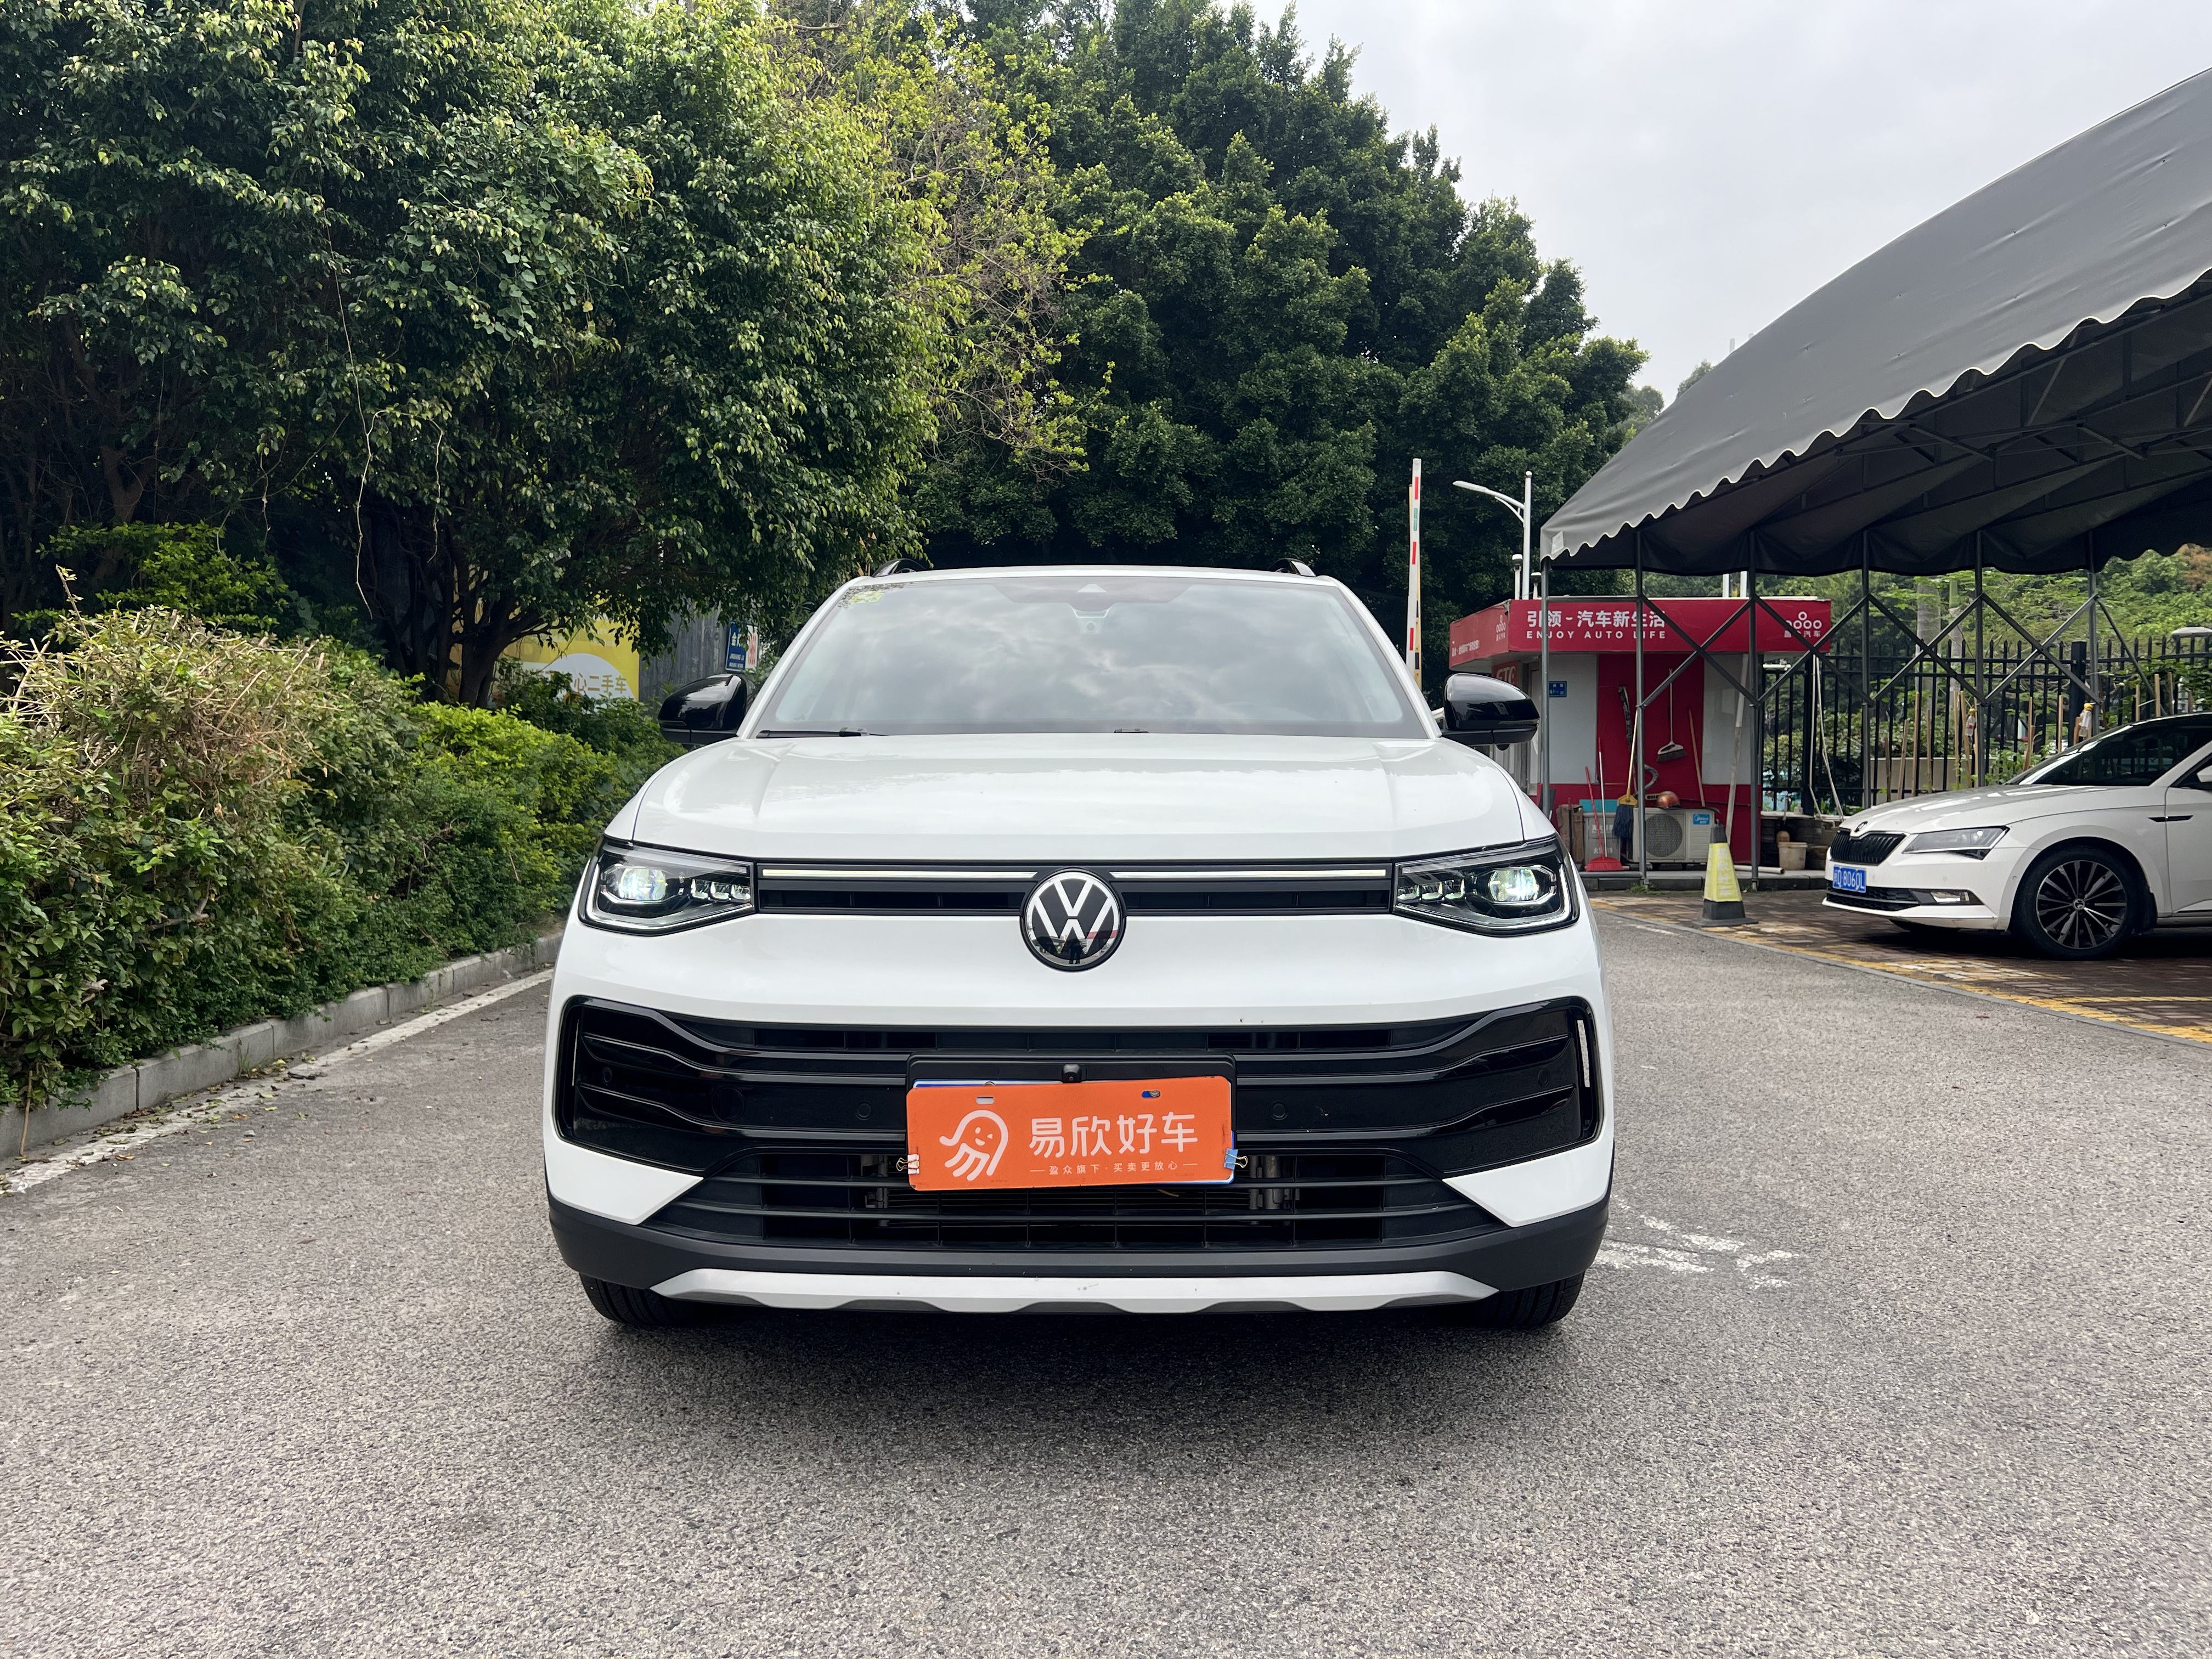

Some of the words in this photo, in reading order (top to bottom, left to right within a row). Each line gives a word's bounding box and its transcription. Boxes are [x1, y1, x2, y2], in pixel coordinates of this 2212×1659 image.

[1527, 631, 1575, 639] ENJOY
[1584, 631, 1623, 639] AUTO
[1633, 631, 1666, 639] LIFE
[574, 672, 627, 694] 心二手车
[1029, 1111, 1198, 1158] 易欣好车
